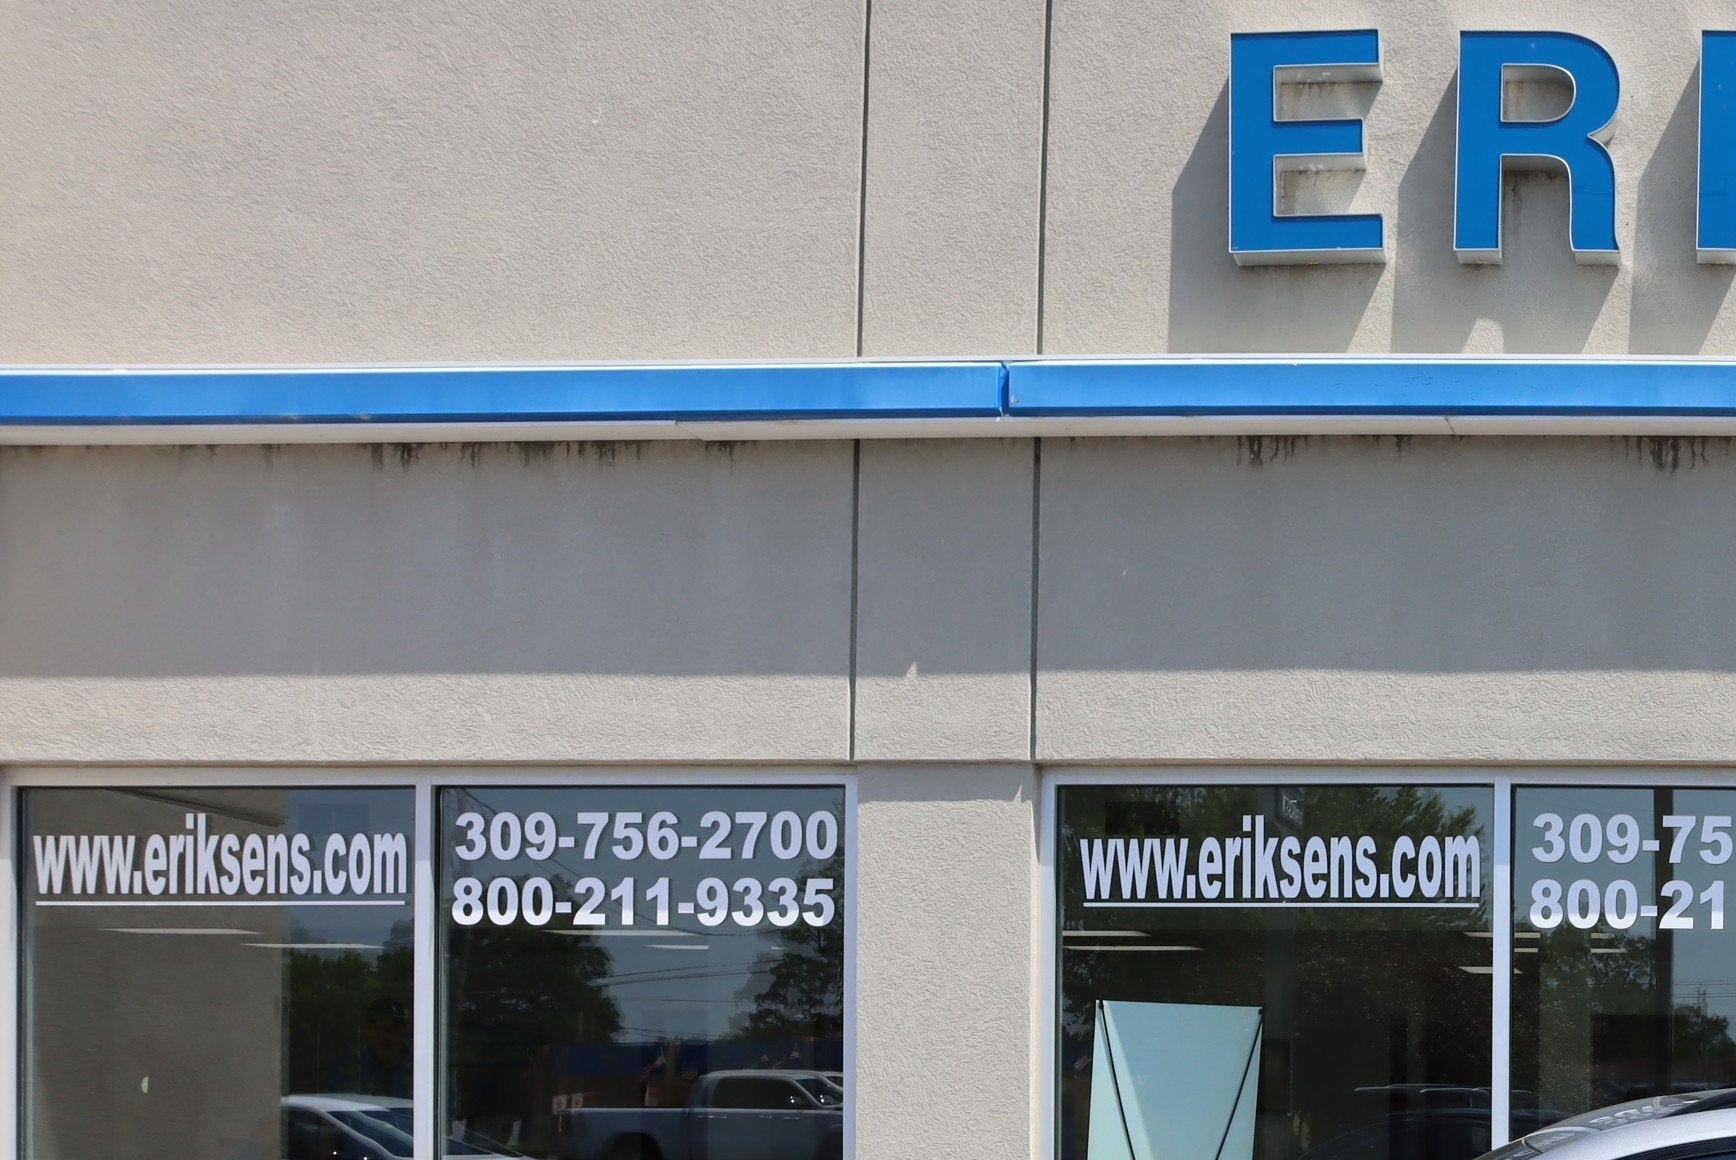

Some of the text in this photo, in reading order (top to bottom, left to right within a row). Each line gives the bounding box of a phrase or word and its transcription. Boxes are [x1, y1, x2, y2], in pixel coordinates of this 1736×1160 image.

[34, 813, 408, 897] www.eriksens.com
[455, 810, 839, 861] 309-756-2700
[1080, 815, 1481, 903] www.eriksens.com
[451, 876, 836, 927] 800-211-9335
